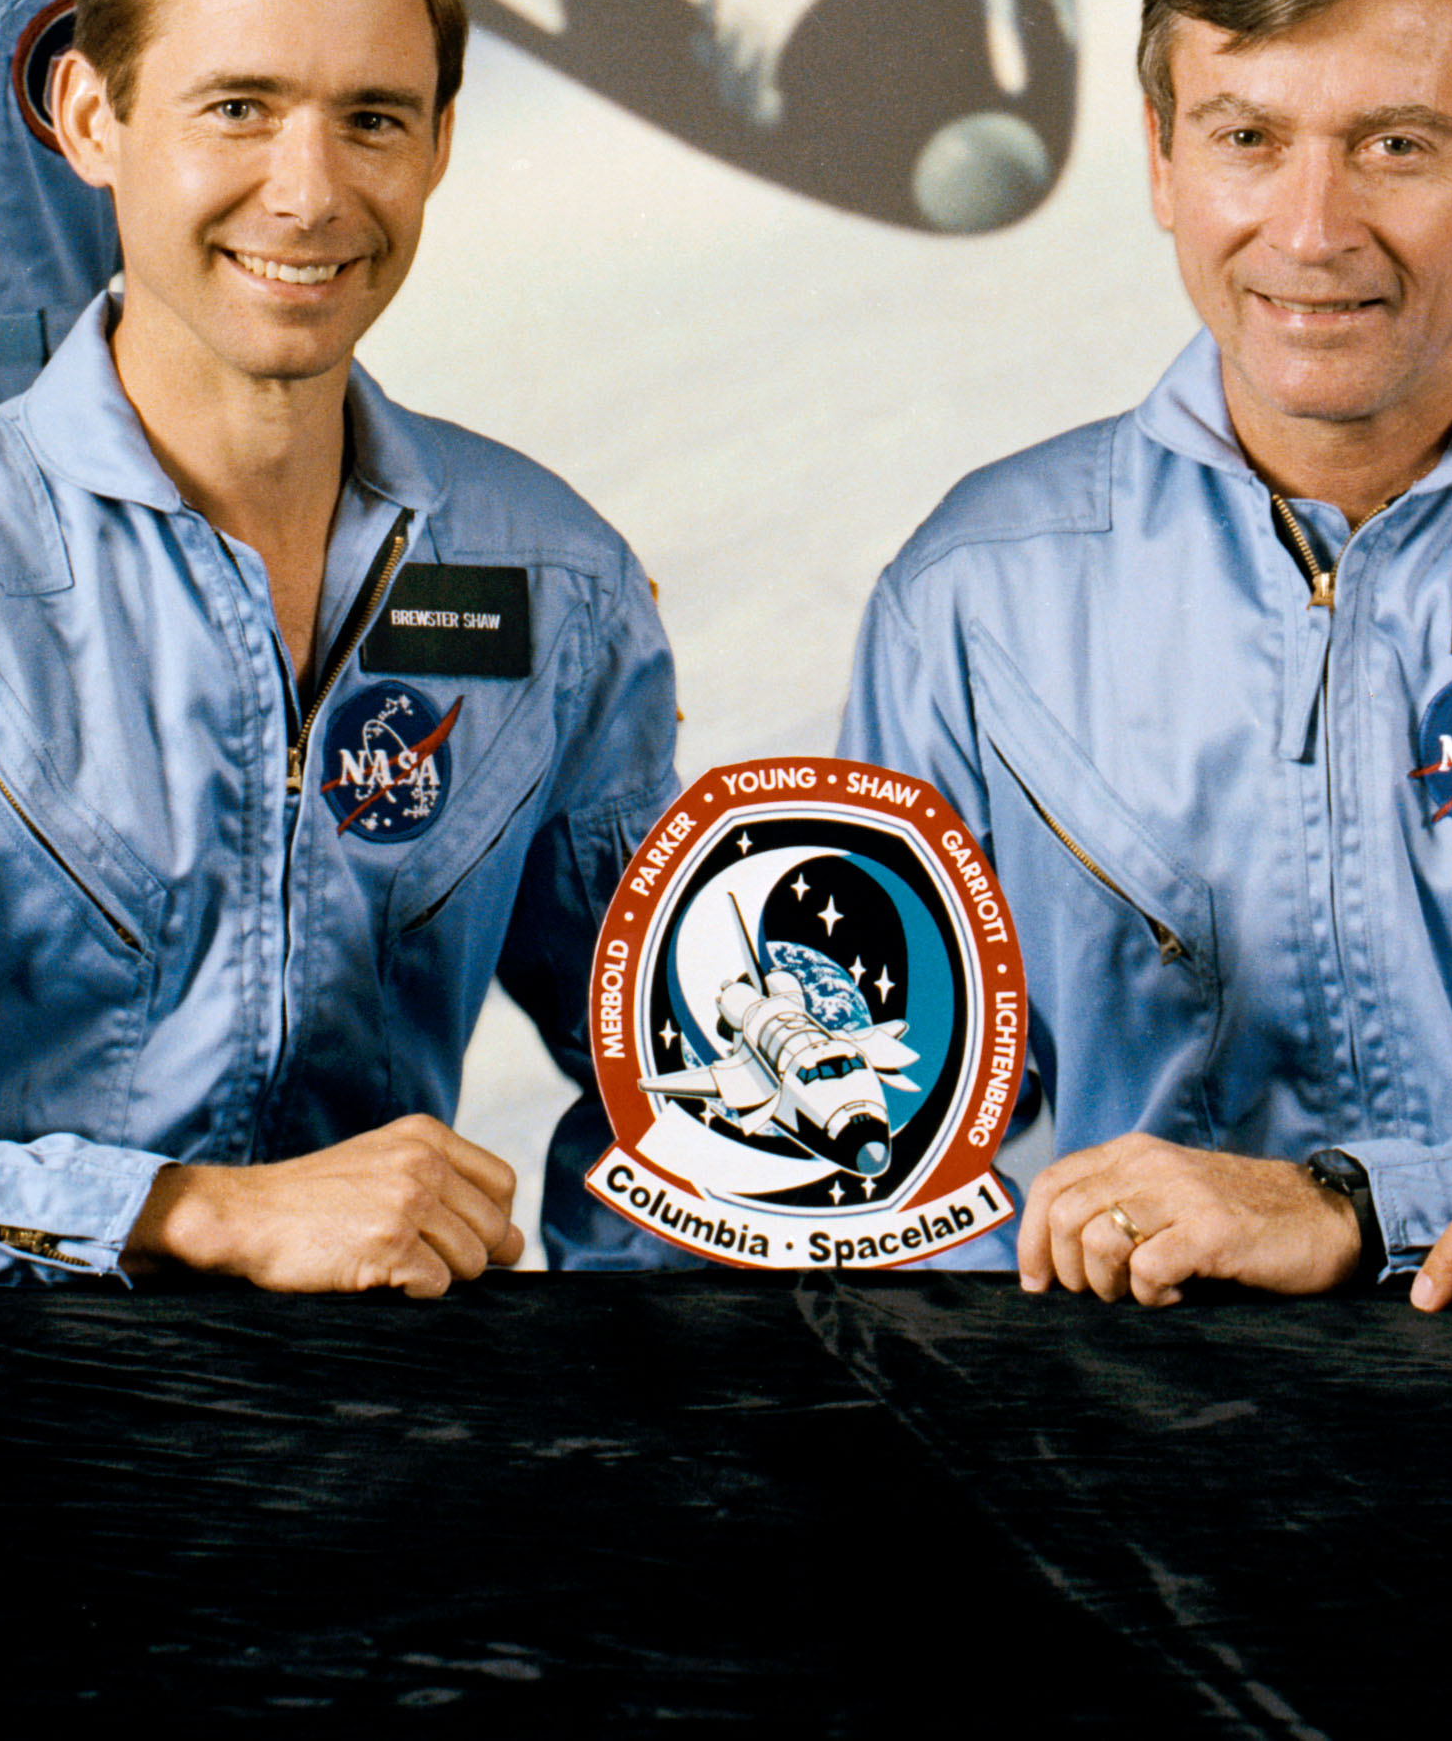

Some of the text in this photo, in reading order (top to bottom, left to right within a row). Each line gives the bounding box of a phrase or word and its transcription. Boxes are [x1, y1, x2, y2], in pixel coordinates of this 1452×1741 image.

[391, 609, 500, 630] BREWSTER SHAW
[338, 748, 441, 786] NASA
[604, 767, 1017, 1147] MERBOLD PARKER YOUNG SHAW GARRIOTT LICHTENBERG
[606, 1164, 1000, 1267] Columbia Spacelab 1
